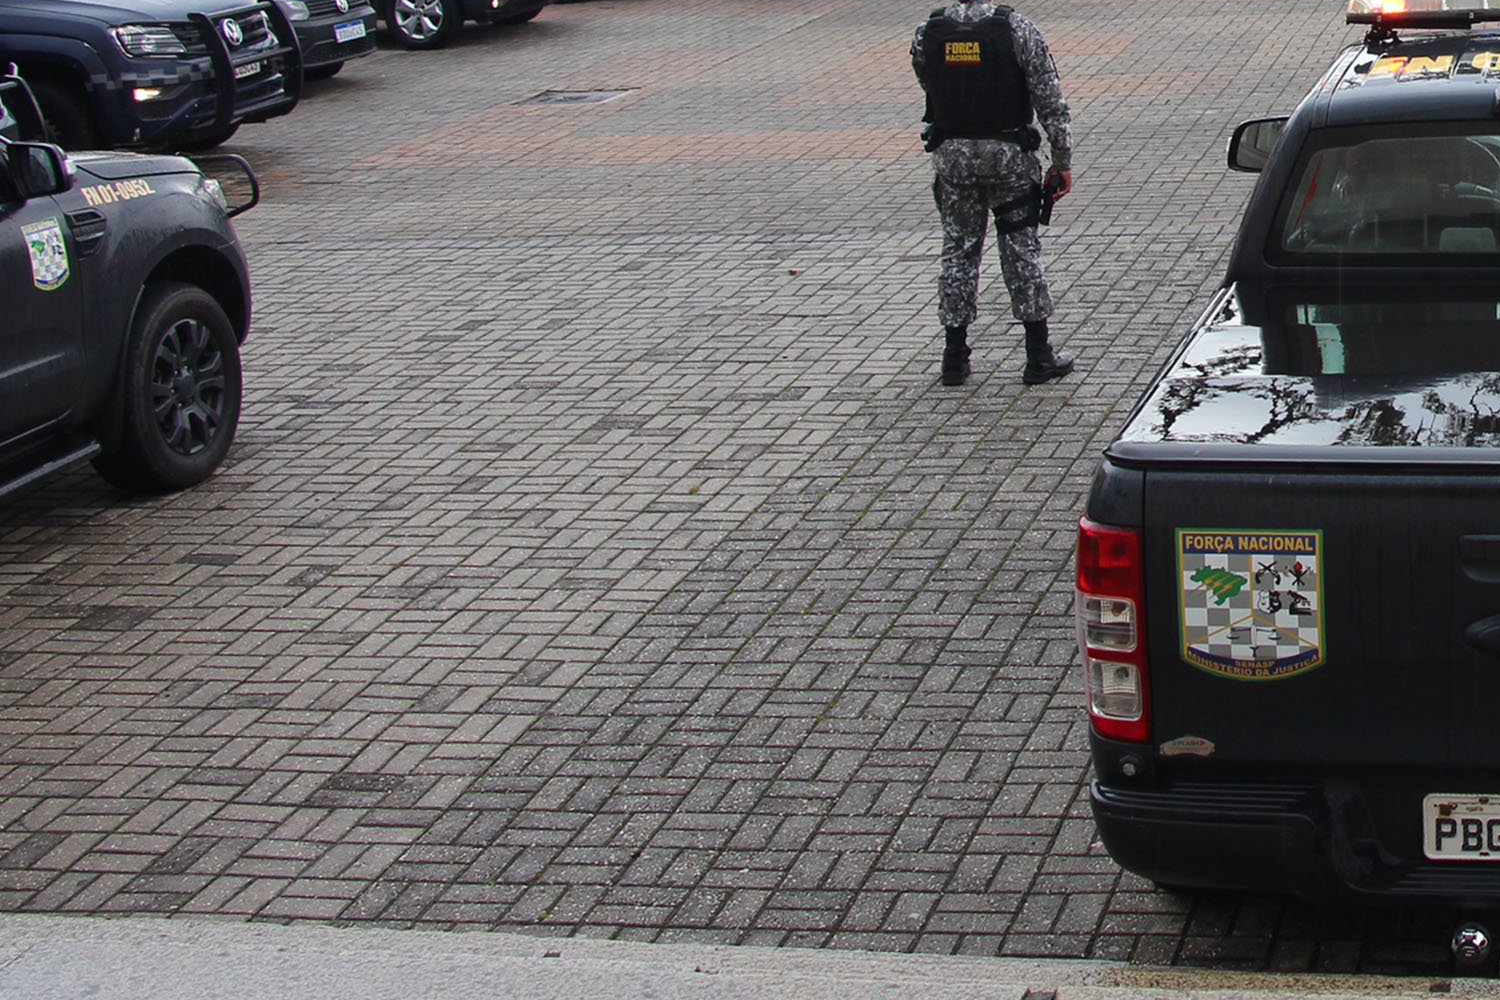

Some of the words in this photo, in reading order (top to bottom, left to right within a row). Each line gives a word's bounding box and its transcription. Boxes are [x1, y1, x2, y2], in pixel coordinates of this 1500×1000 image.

[81, 186, 103, 205] FN
[102, 179, 156, 204] 01-0952
[1185, 535, 1234, 552] FORÇA
[1238, 536, 1313, 551] NACIONAL
[1235, 660, 1276, 668] SENASP
[1255, 668, 1270, 676] DA
